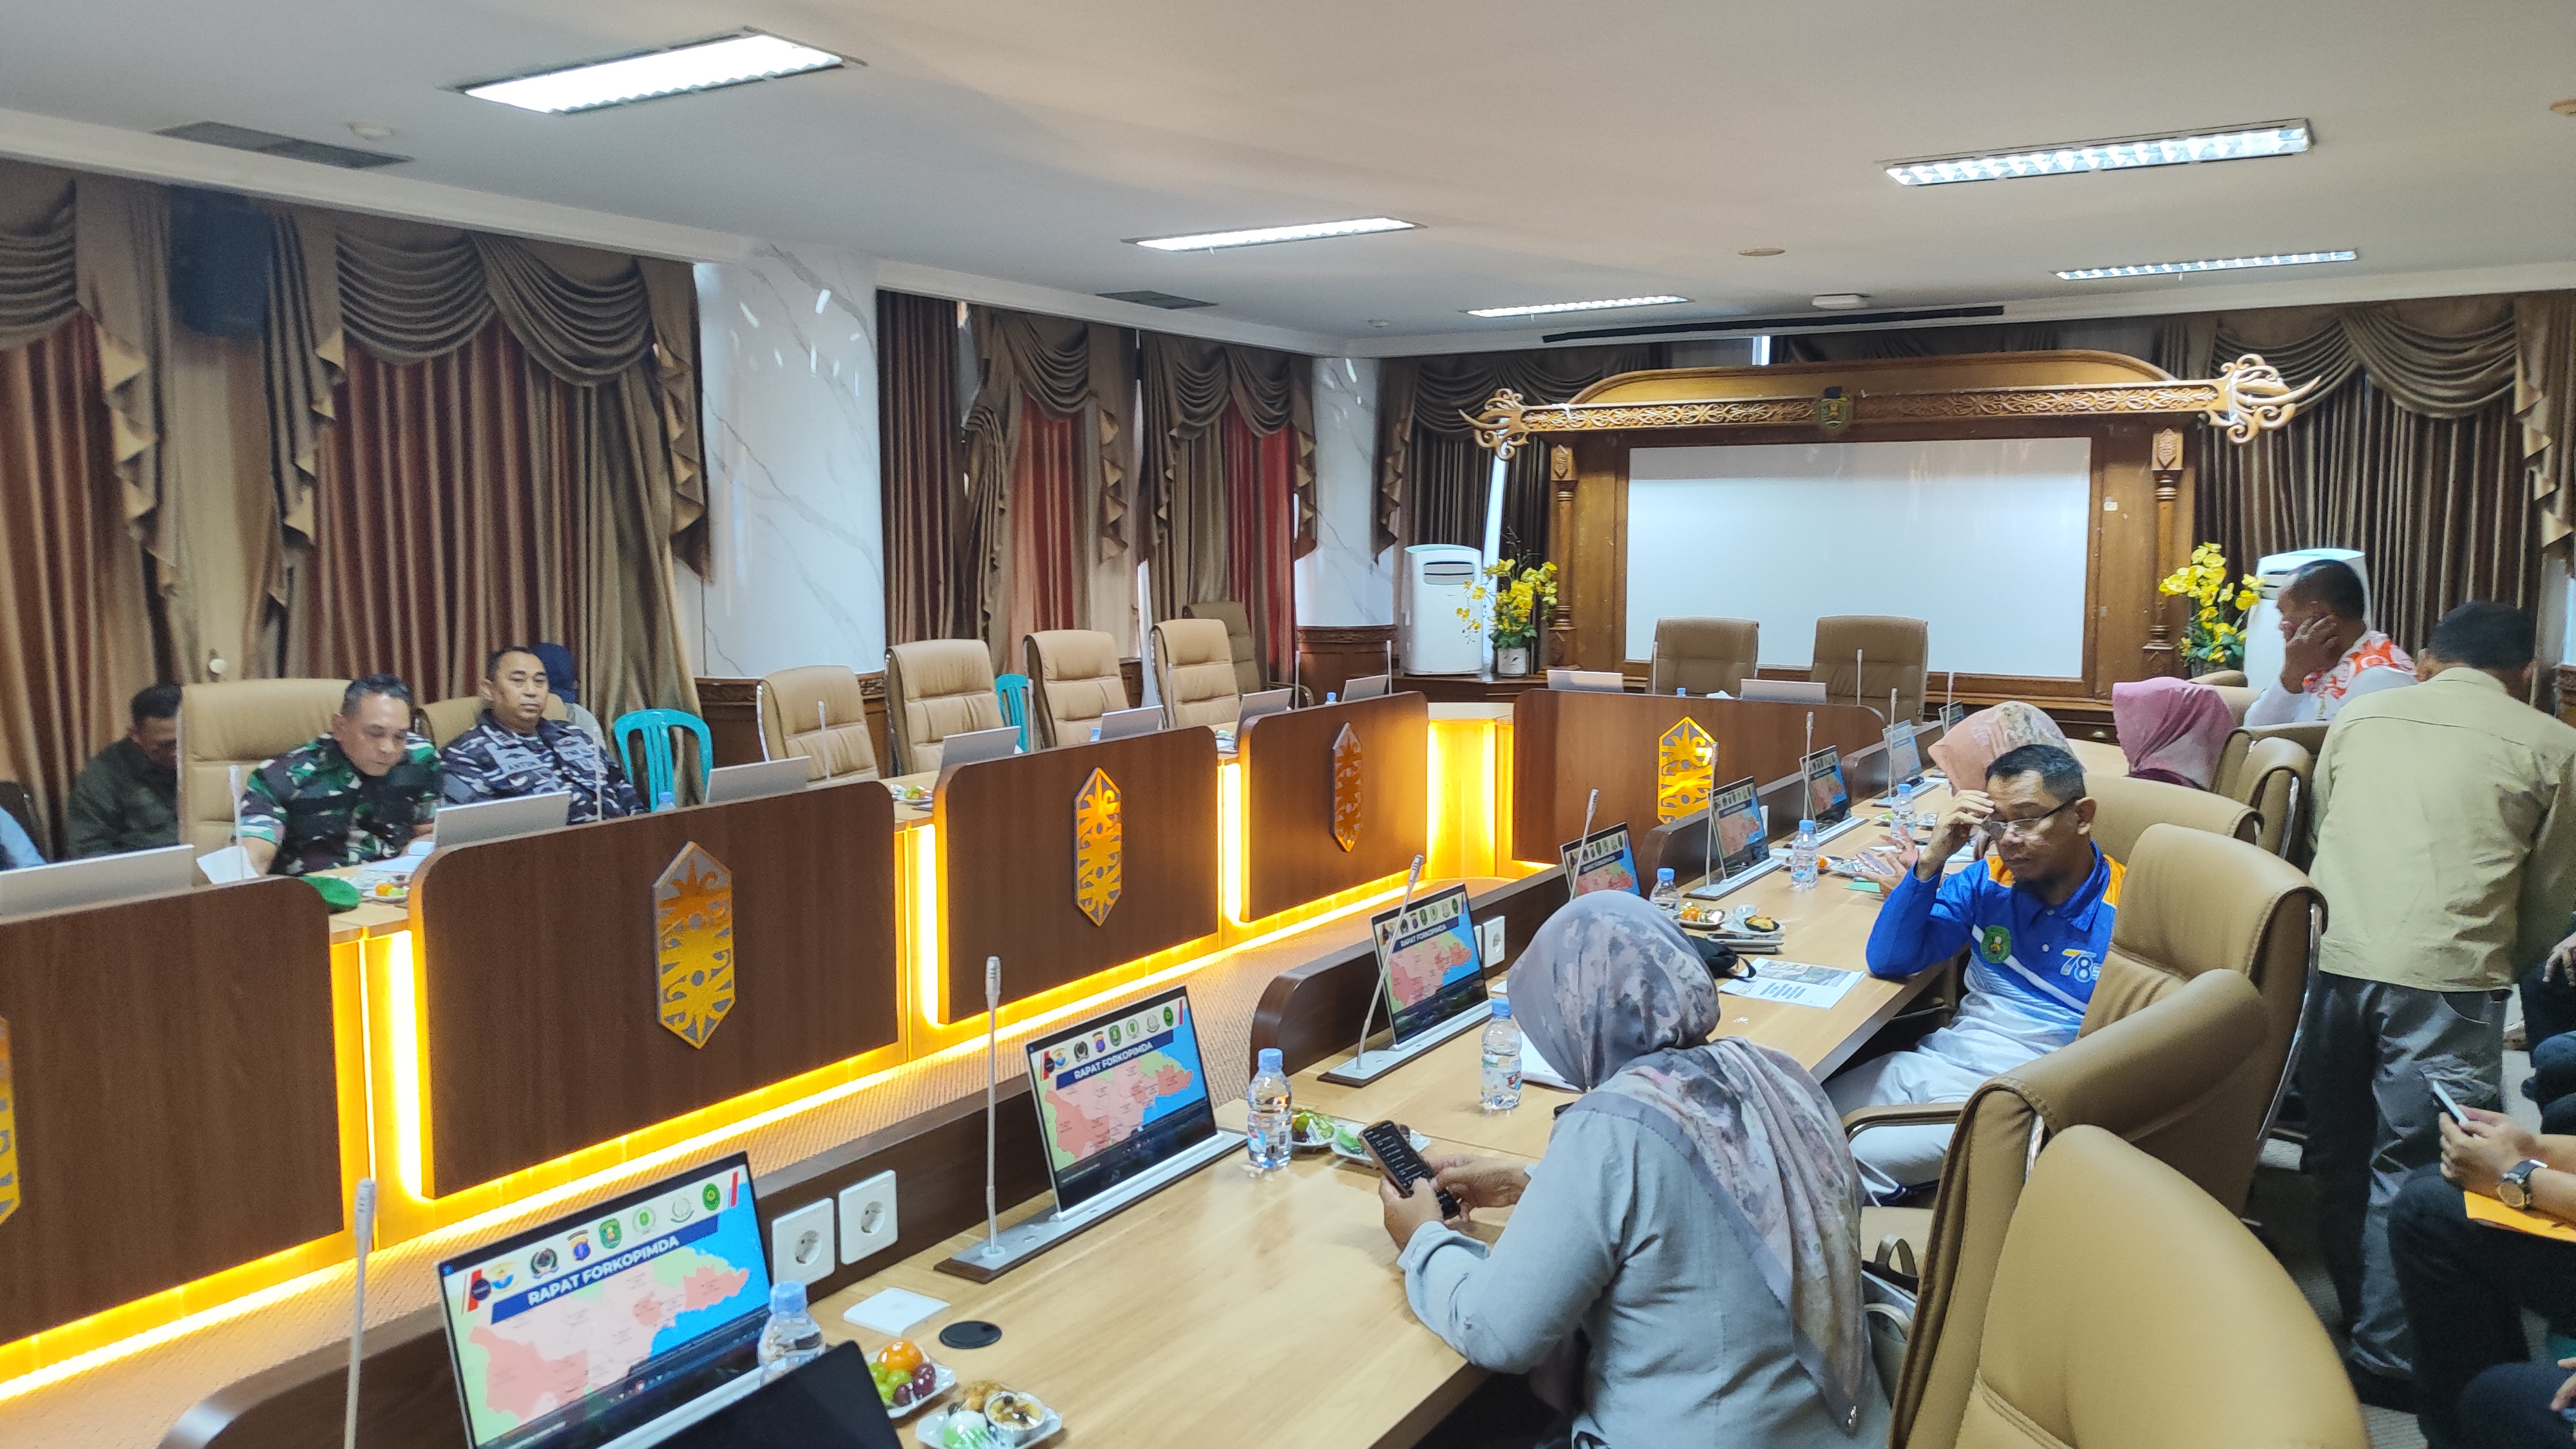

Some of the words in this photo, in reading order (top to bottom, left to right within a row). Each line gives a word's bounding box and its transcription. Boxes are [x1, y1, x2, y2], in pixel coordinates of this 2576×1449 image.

[2060, 948, 2097, 983] 78
[1074, 1061, 1101, 1079] RAPAT
[527, 1273, 580, 1306] RAPAT
[581, 1235, 680, 1284] FORKOPIMDA
